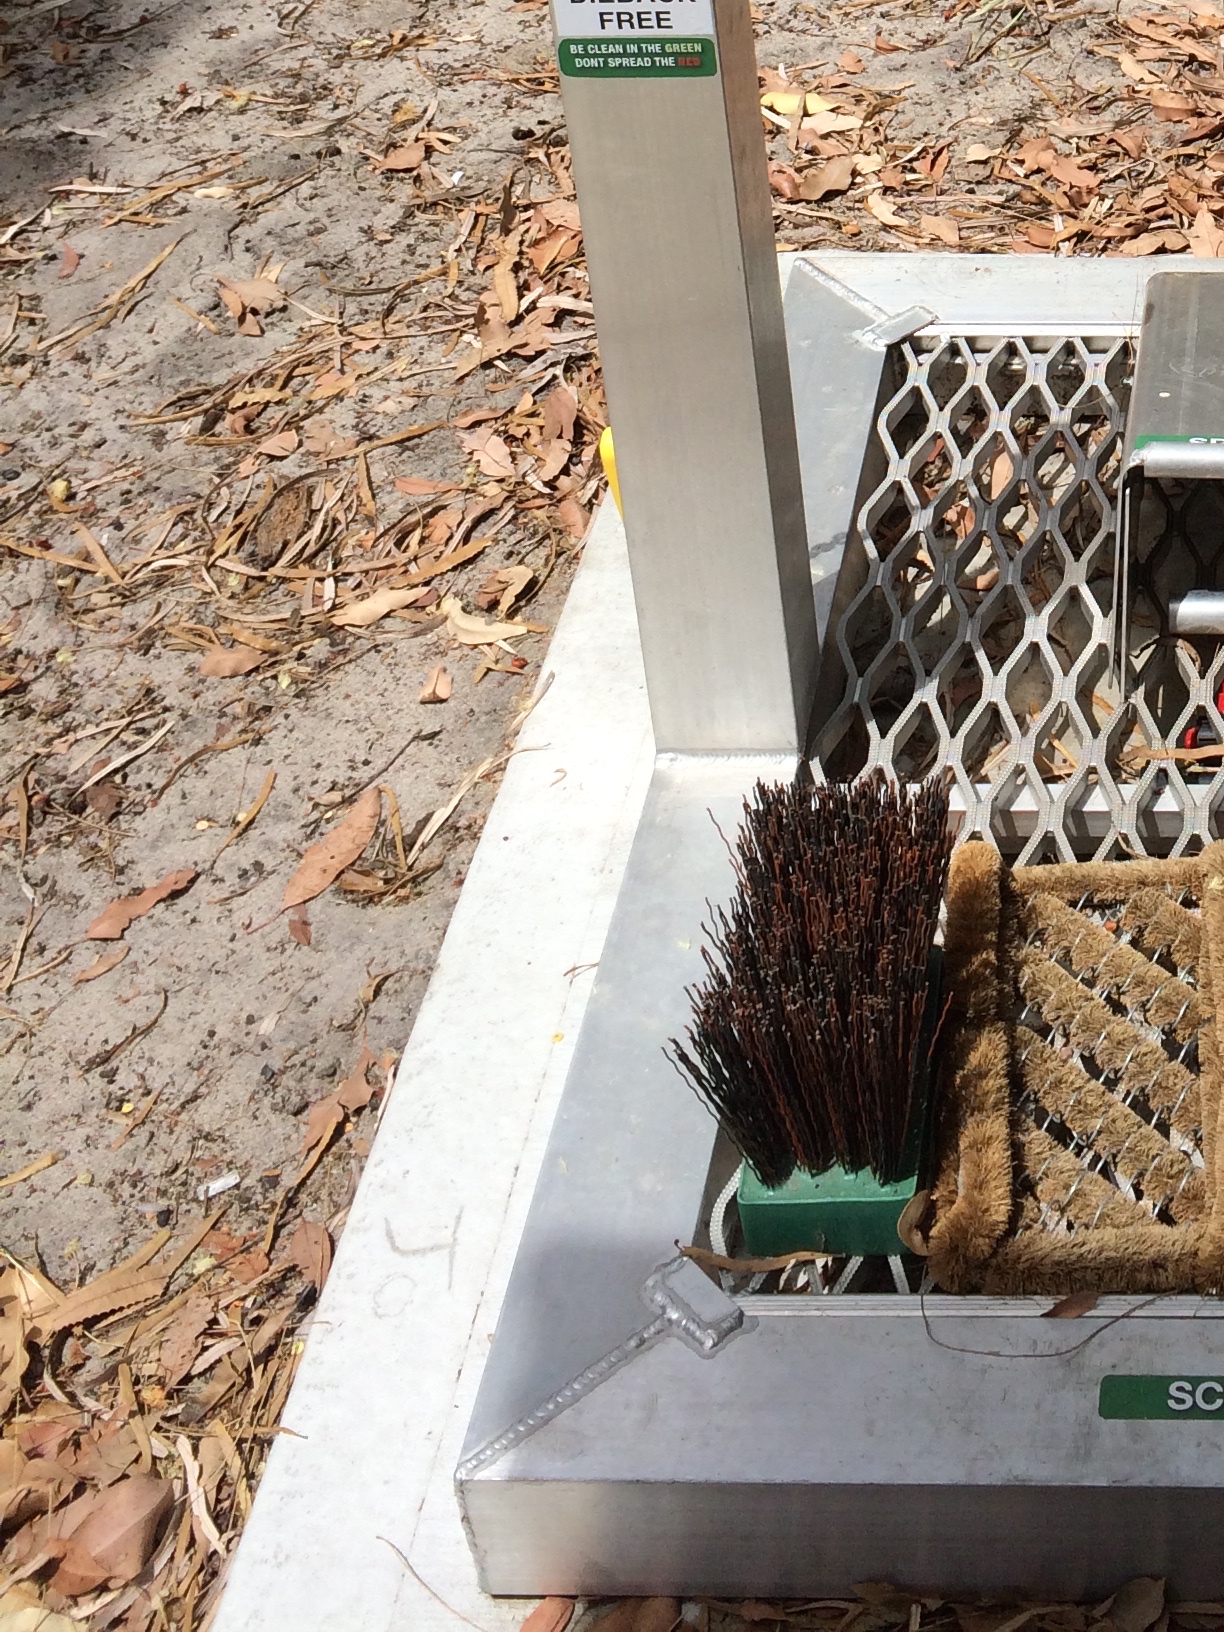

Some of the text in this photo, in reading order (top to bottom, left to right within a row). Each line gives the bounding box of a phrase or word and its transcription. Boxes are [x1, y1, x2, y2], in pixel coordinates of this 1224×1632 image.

[598, 11, 673, 30] FREE
[570, 43, 702, 54] BE CLEAN IN THE GREEN
[575, 57, 700, 67] DONT SPREAD THE RED
